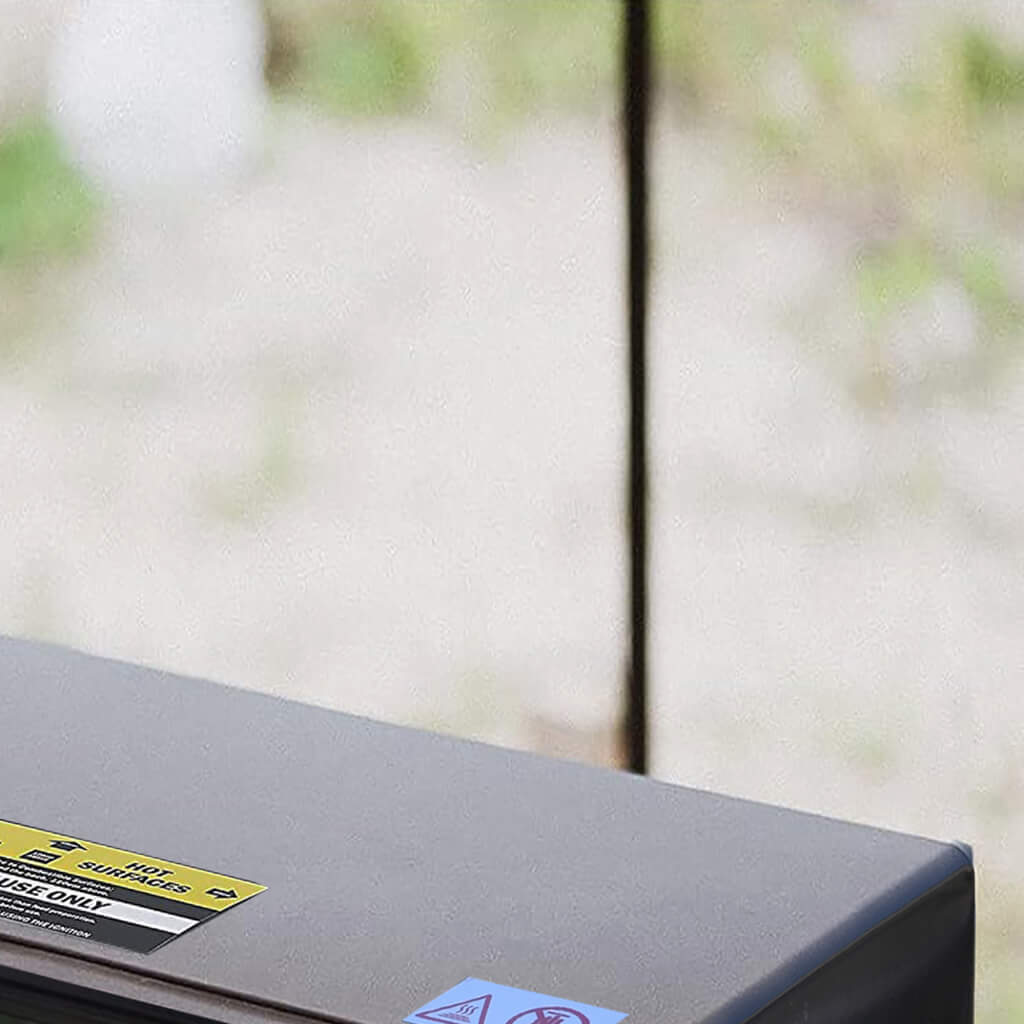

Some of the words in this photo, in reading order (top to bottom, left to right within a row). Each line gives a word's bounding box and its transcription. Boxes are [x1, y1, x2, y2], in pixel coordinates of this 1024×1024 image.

[77, 861, 192, 894] SURFACES
[125, 861, 174, 877] HOT
[46, 891, 112, 911] ONLY
[0, 911, 31, 923] USING
[31, 918, 50, 928] THE
[49, 923, 92, 939] IGNITION
